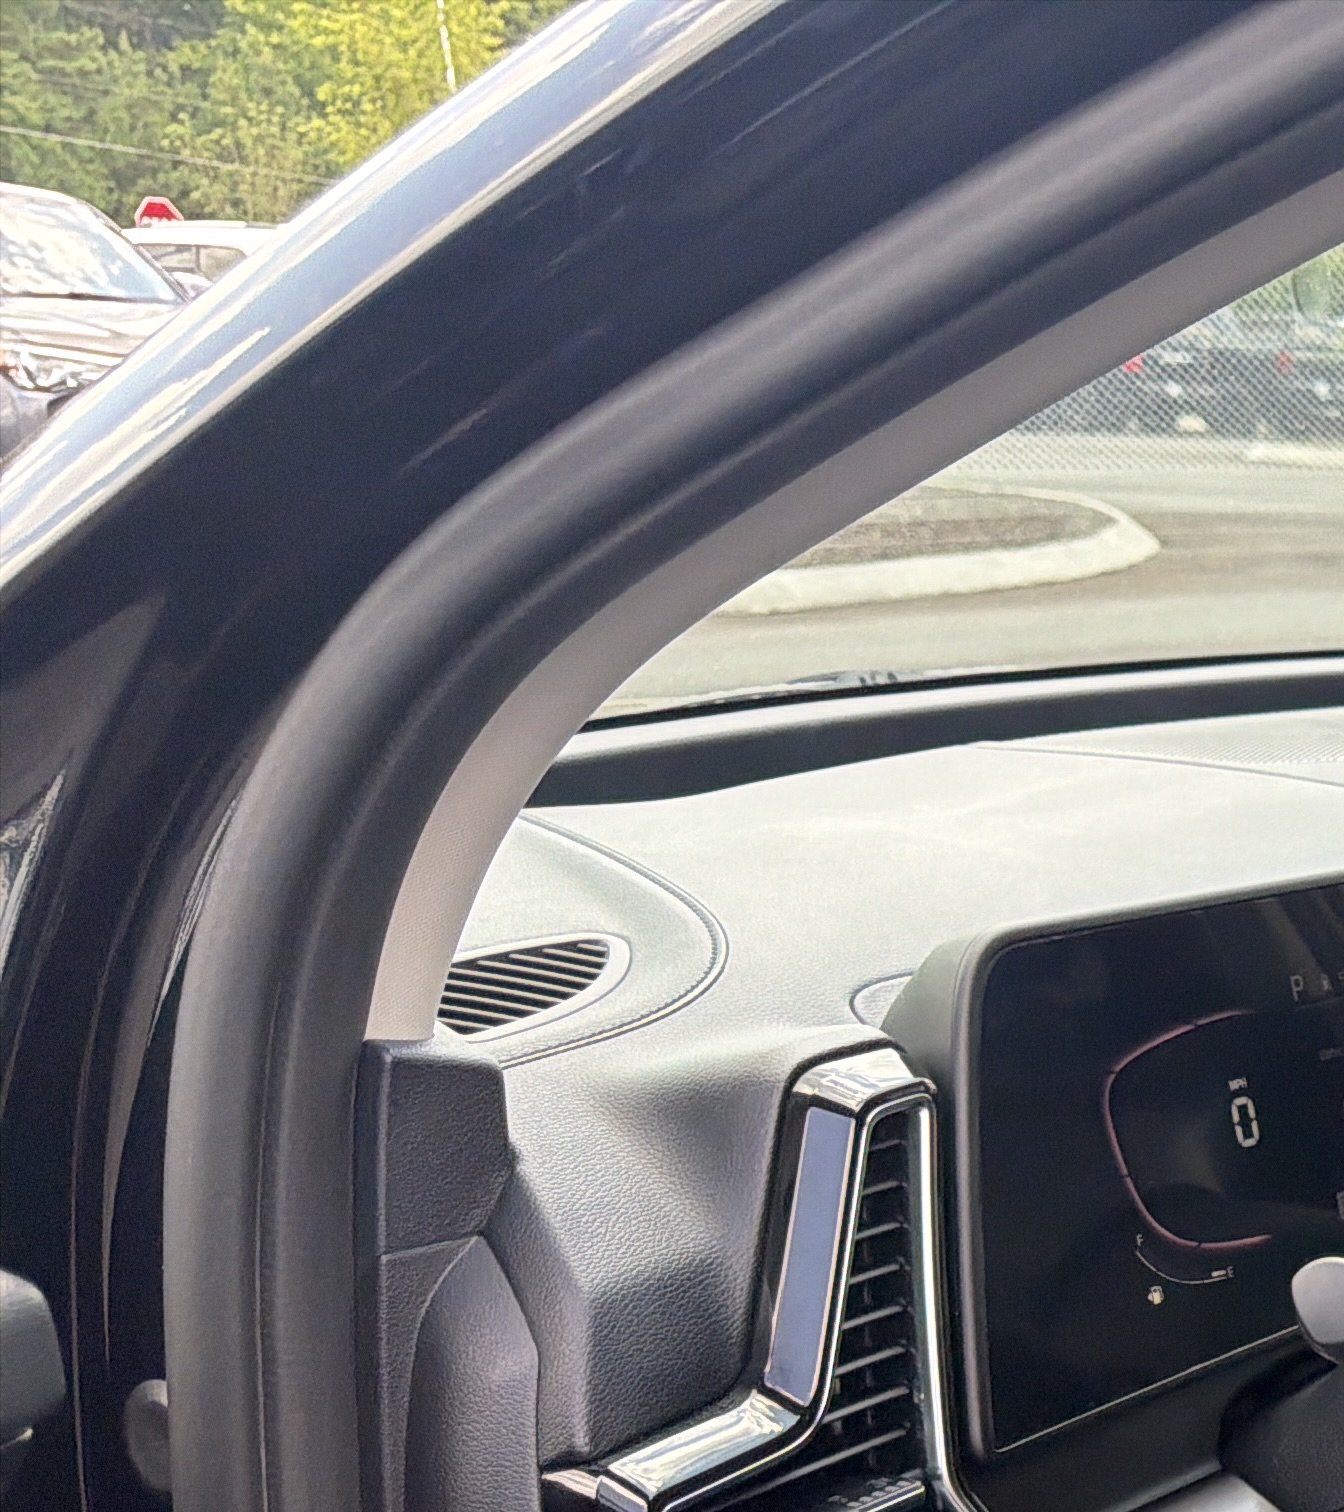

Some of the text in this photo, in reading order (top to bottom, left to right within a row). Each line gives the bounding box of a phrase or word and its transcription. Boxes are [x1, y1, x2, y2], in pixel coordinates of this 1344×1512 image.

[1289, 974, 1304, 1003] P
[1228, 1077, 1248, 1094] MPH
[1230, 1095, 1260, 1148] 0
[1137, 1234, 1144, 1246] F
[1227, 1266, 1235, 1278] E
